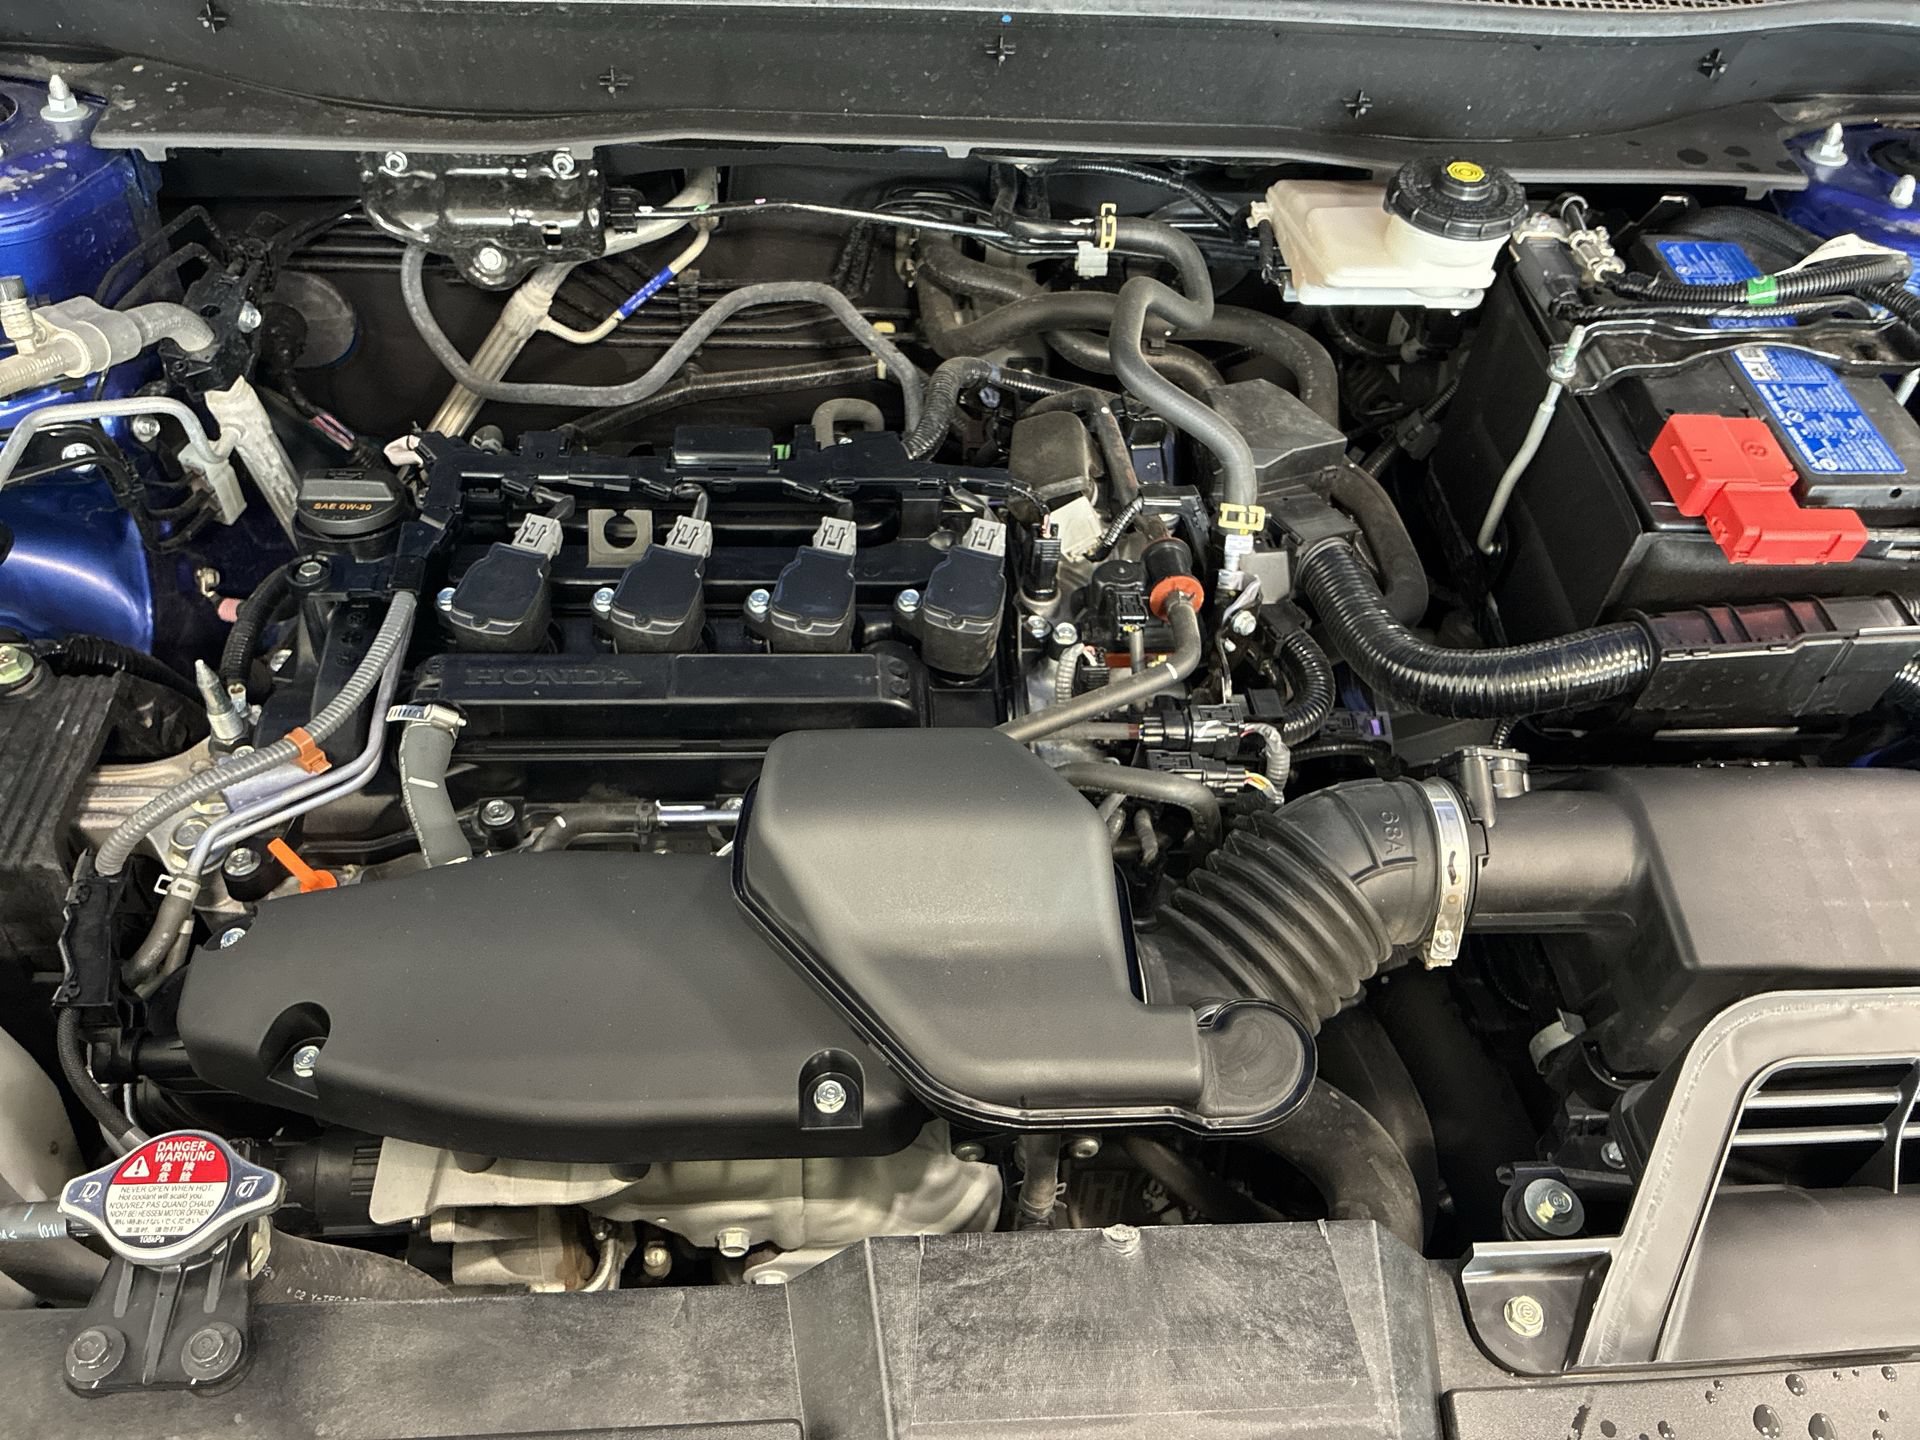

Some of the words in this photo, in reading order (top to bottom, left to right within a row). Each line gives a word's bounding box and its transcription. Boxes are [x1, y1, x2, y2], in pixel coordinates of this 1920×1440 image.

[313, 502, 337, 510] SAE
[338, 503, 372, 511] 0W-20
[464, 668, 642, 685] HONDA
[1381, 811, 1404, 855] 68A
[156, 1140, 207, 1152] DANGER
[154, 1150, 216, 1162] WARNUNG
[109, 1201, 145, 1209] N'OUVREZ
[161, 1200, 188, 1208] QUAND
[189, 1200, 215, 1208] CHAUD
[110, 1210, 127, 1218] NICHT
[140, 1235, 165, 1244] 108kPa
